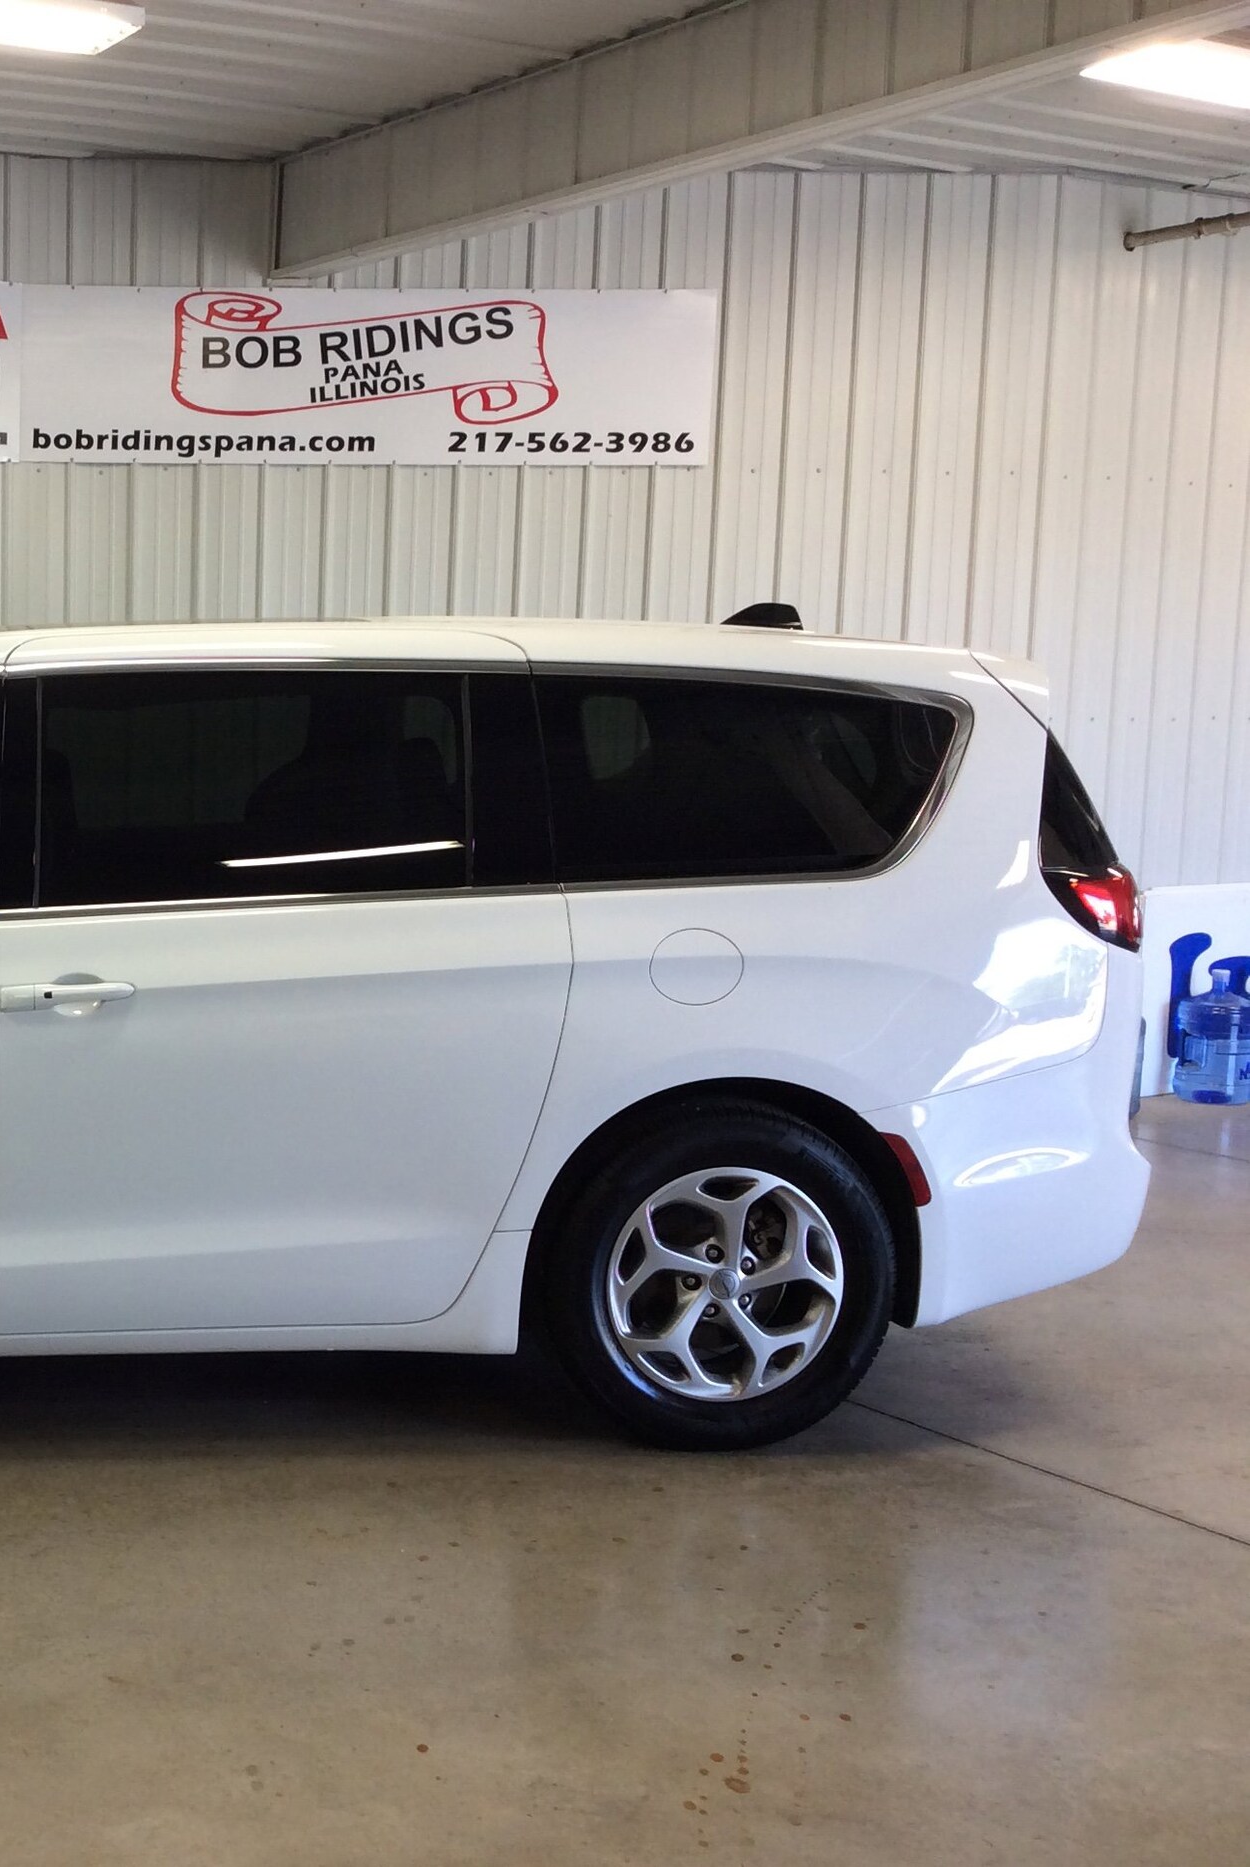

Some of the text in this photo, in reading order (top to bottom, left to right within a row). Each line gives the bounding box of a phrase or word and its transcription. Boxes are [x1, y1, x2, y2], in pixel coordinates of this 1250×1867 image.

[202, 306, 514, 369] BOB RIDINGS
[323, 359, 403, 384] PANA
[309, 374, 426, 403] ILLINOIS
[32, 428, 376, 458] bobridingspana.com
[447, 432, 695, 453] 217-562-3986
